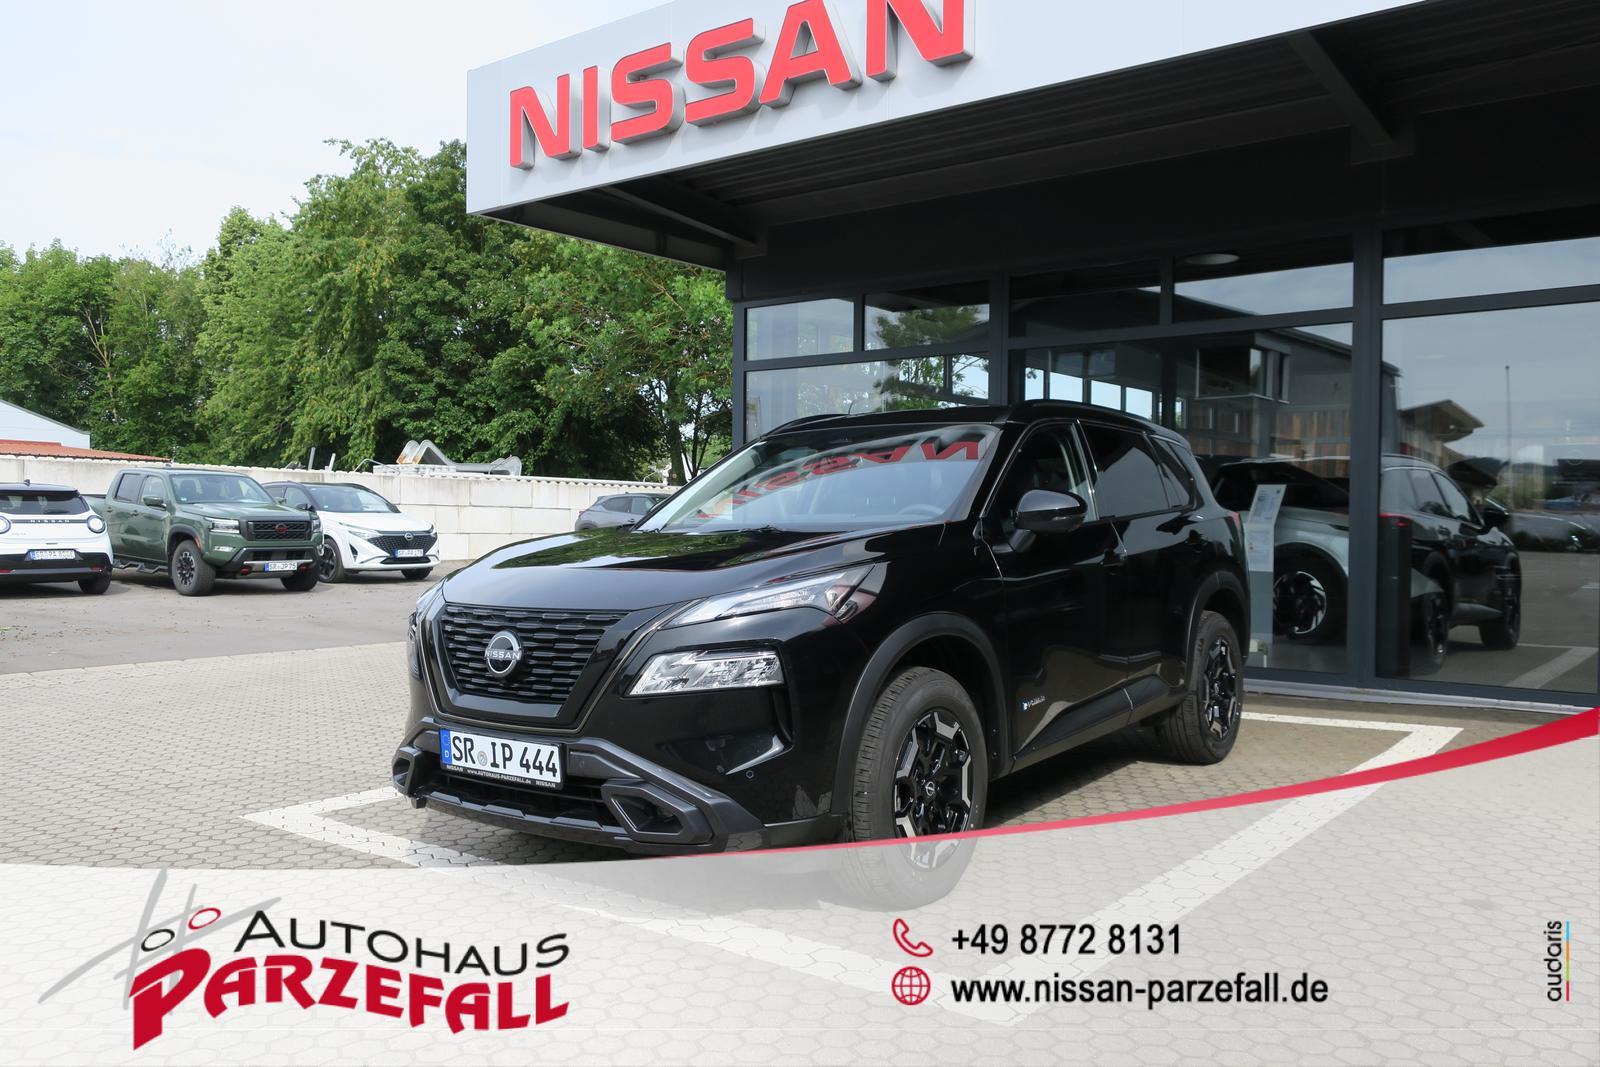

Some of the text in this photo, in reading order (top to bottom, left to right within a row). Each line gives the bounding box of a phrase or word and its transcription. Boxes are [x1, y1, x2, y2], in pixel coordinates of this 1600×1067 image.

[509, 0, 973, 169] NISSAN
[484, 650, 522, 660] NISSAN
[452, 736, 476, 764] SR
[490, 741, 513, 769] IP
[519, 746, 558, 778] 444
[446, 764, 464, 772] NISSAN
[535, 780, 556, 788] NISSAN
